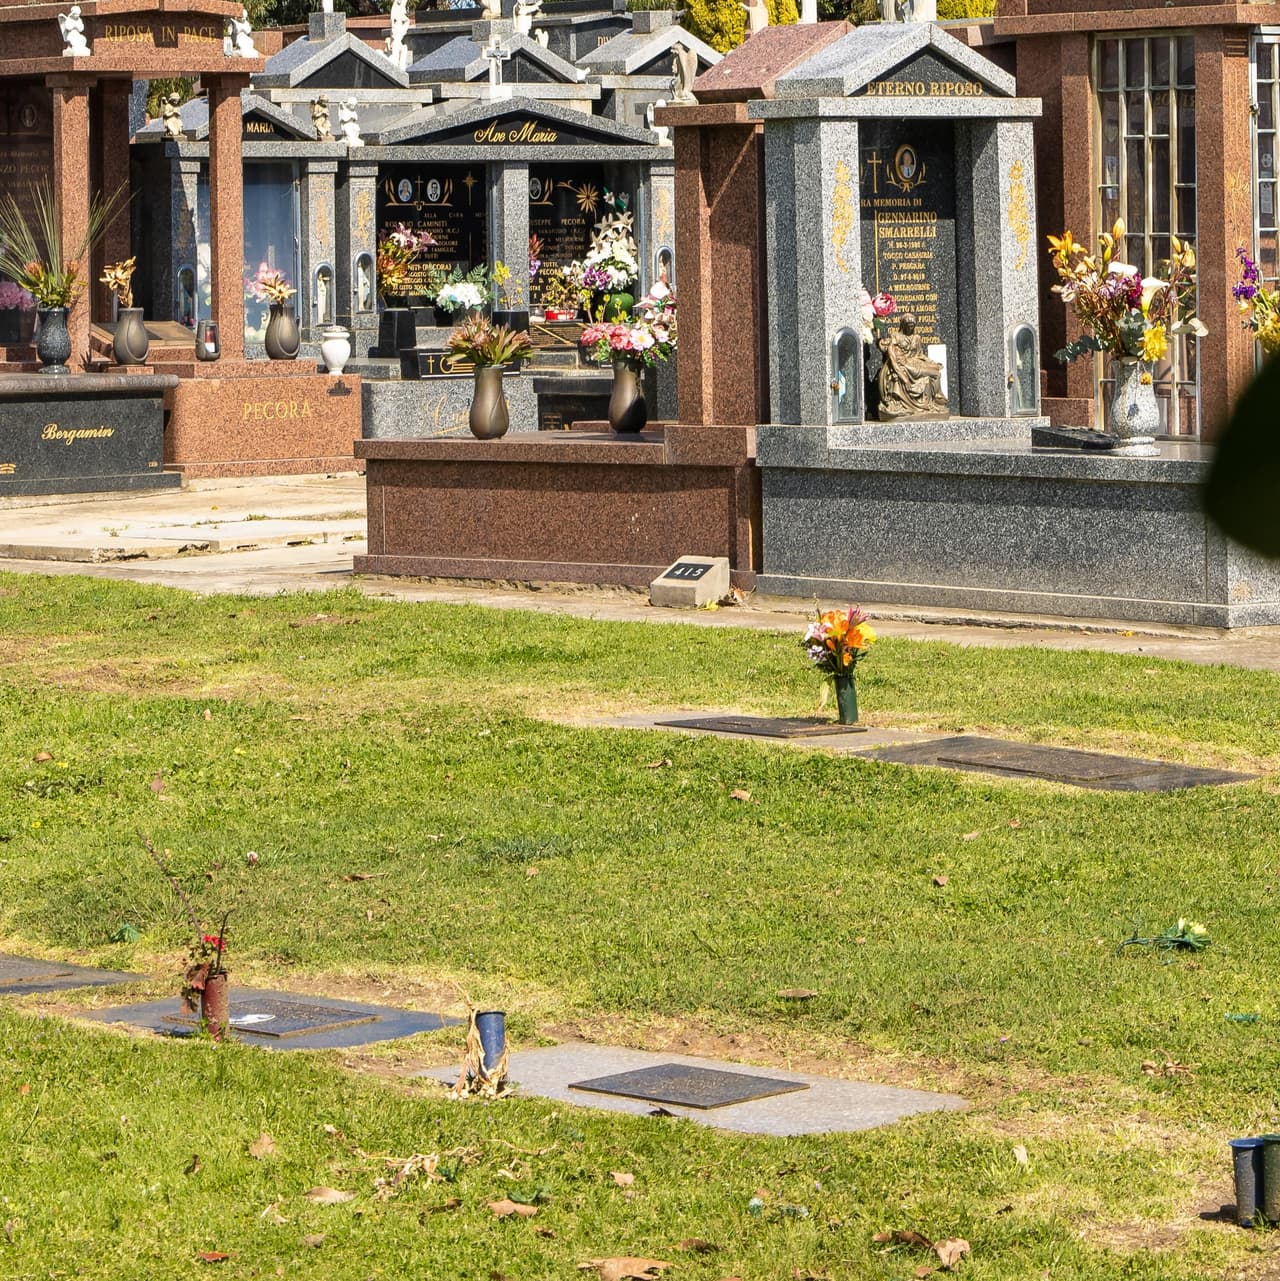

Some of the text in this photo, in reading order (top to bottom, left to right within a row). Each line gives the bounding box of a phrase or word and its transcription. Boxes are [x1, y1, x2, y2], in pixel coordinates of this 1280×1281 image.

[104, 24, 216, 42] RIPOSA IN PACE
[866, 81, 983, 96] ETERNO RIPOSO
[247, 122, 274, 133] MARIA
[473, 120, 558, 143] Ave Maria
[873, 198, 911, 207] MEMORIA
[913, 198, 922, 206] DI
[878, 212, 938, 223] GENNARINO
[879, 226, 937, 238] SMARRELLI
[243, 400, 311, 420] PECORA
[41, 423, 115, 445] Bergamin
[673, 567, 704, 577] 415
